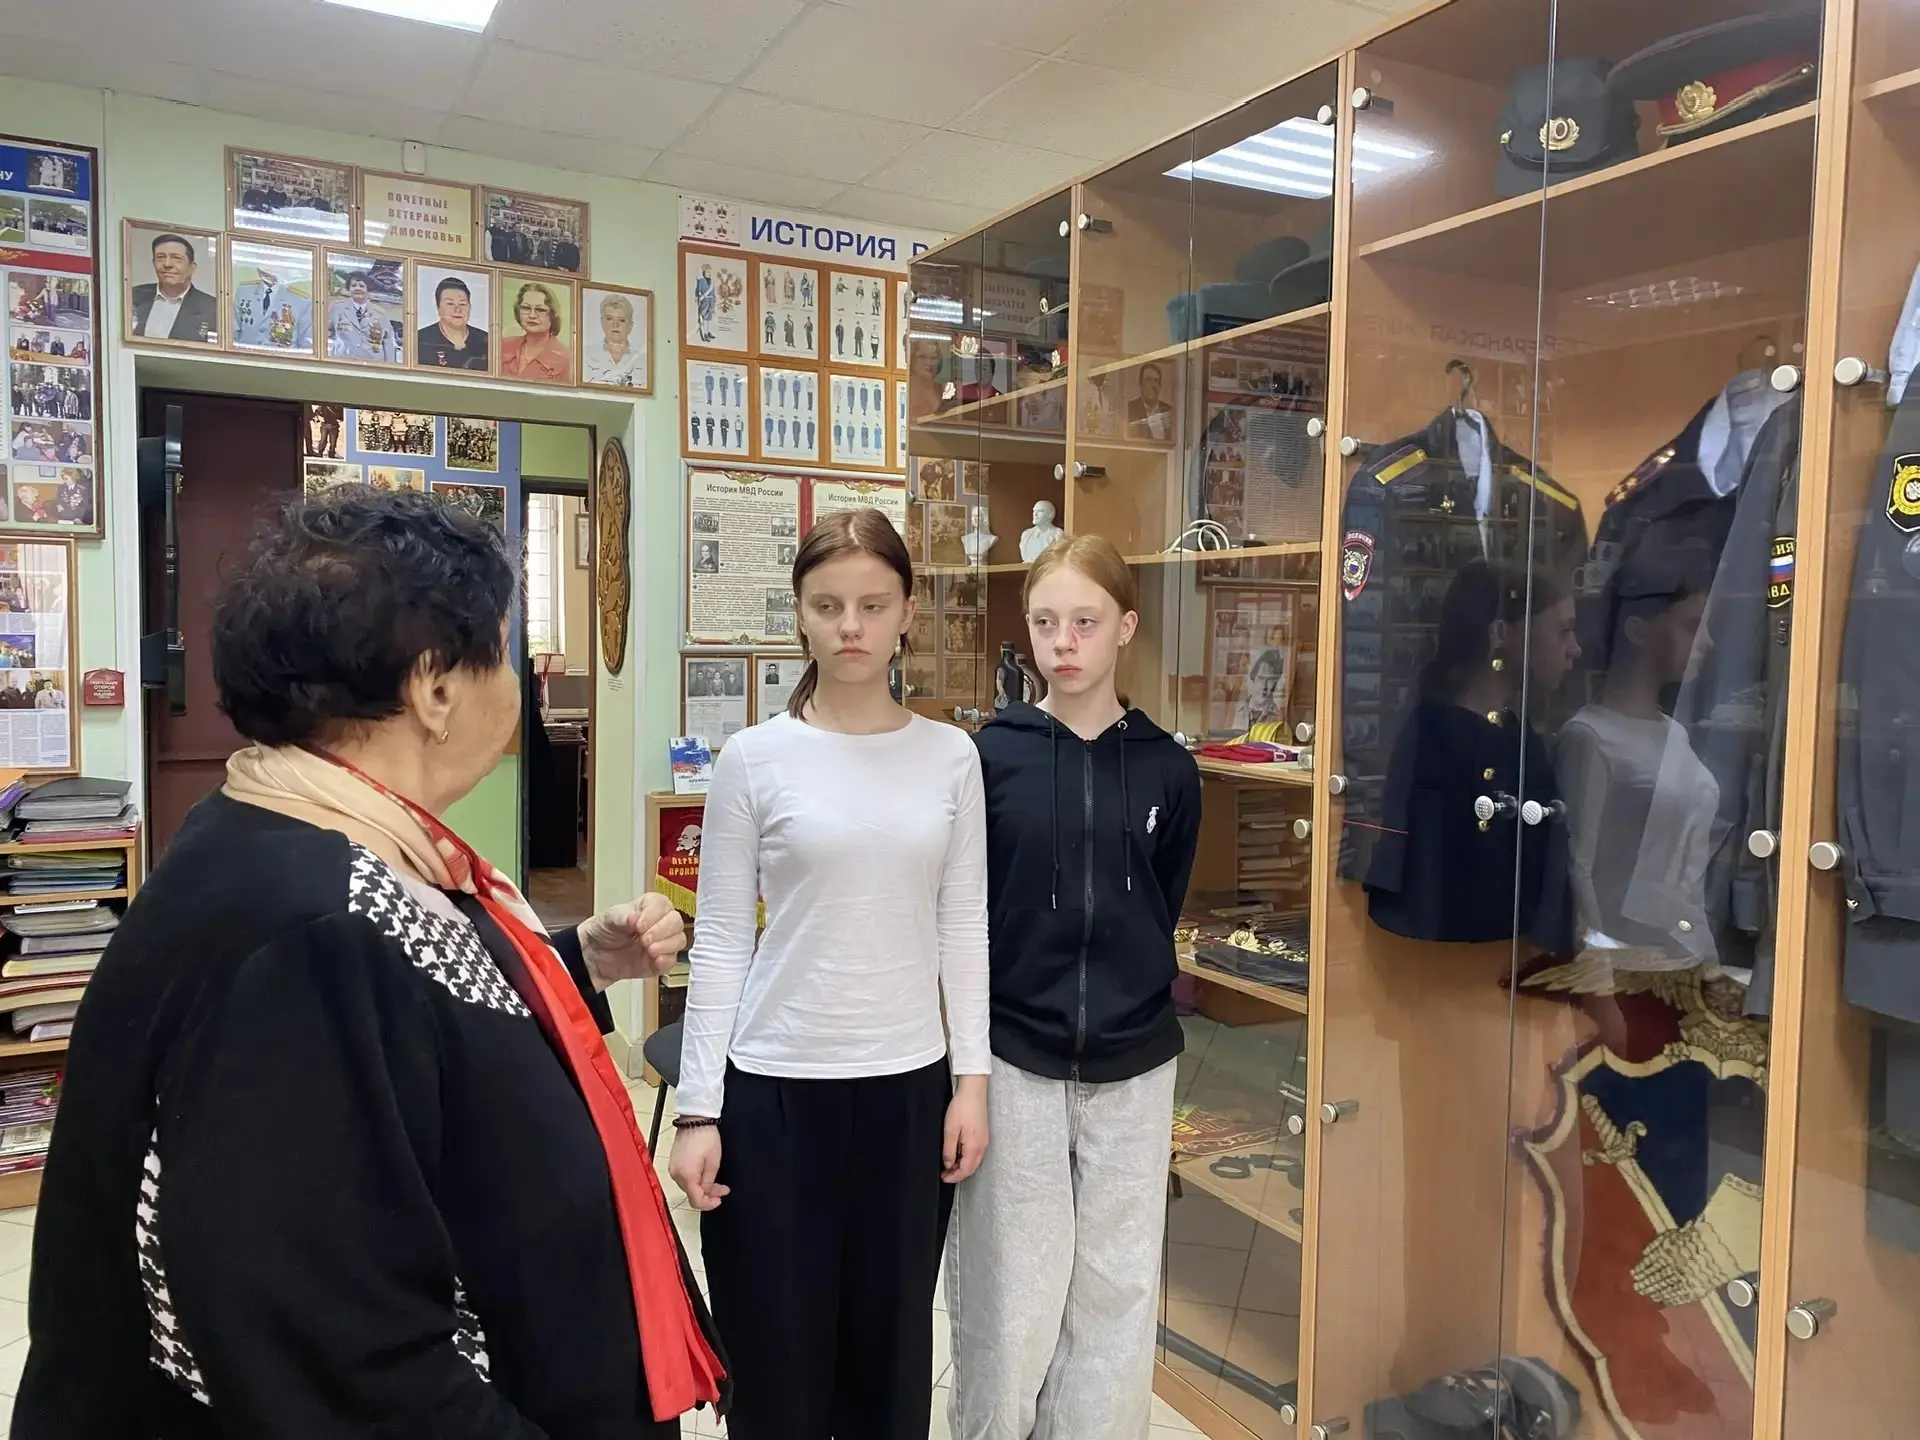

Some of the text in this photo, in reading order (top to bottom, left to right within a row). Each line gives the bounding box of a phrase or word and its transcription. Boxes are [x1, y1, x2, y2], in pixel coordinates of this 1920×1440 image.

[388, 208, 448, 225] ВЕТЕРАНЫ
[387, 225, 462, 244] ДМОСКОВЬЯ
[751, 216, 896, 261] ИСТОРИЯ
[706, 483, 784, 497] История МВД России
[828, 493, 898, 505] История МВД России
